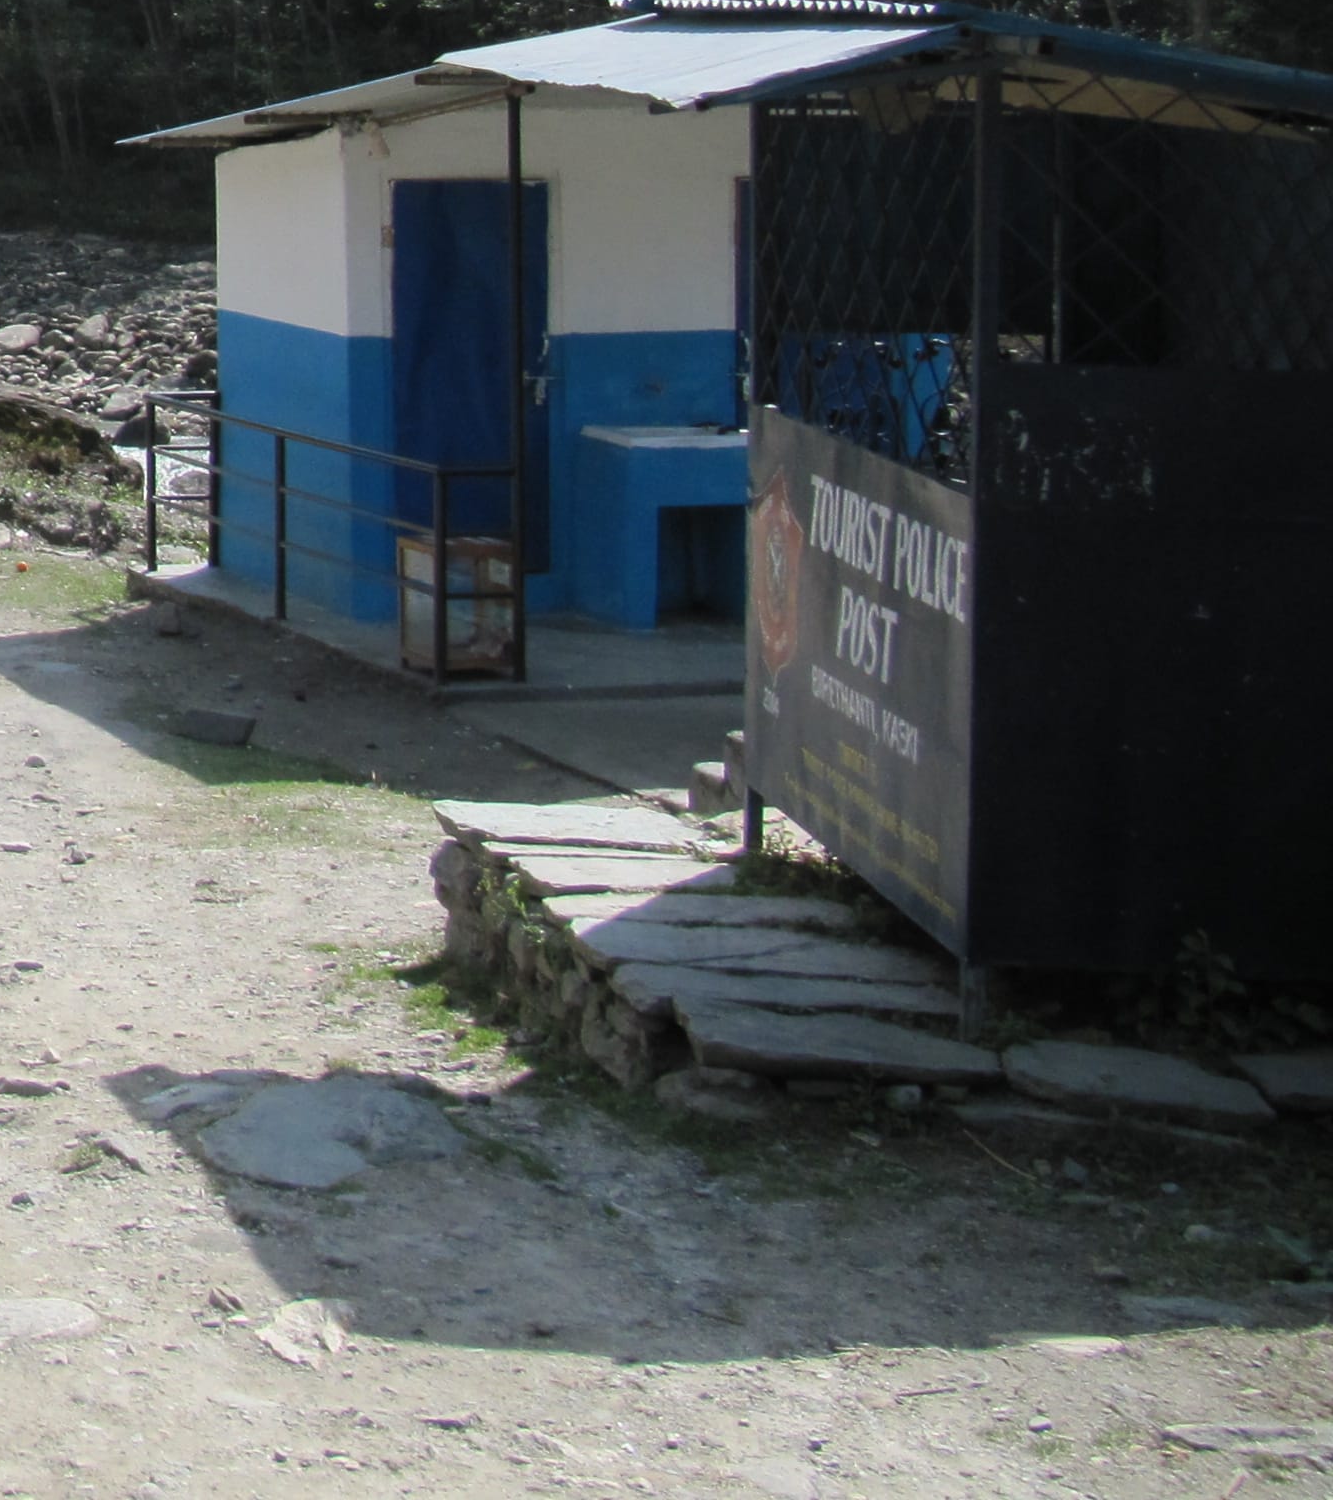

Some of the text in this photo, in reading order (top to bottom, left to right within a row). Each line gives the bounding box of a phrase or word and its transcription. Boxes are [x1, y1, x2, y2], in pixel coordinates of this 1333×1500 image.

[809, 474, 968, 624] TOURIST POLICE
[836, 585, 899, 685] POST
[882, 708, 920, 765] KASKI
